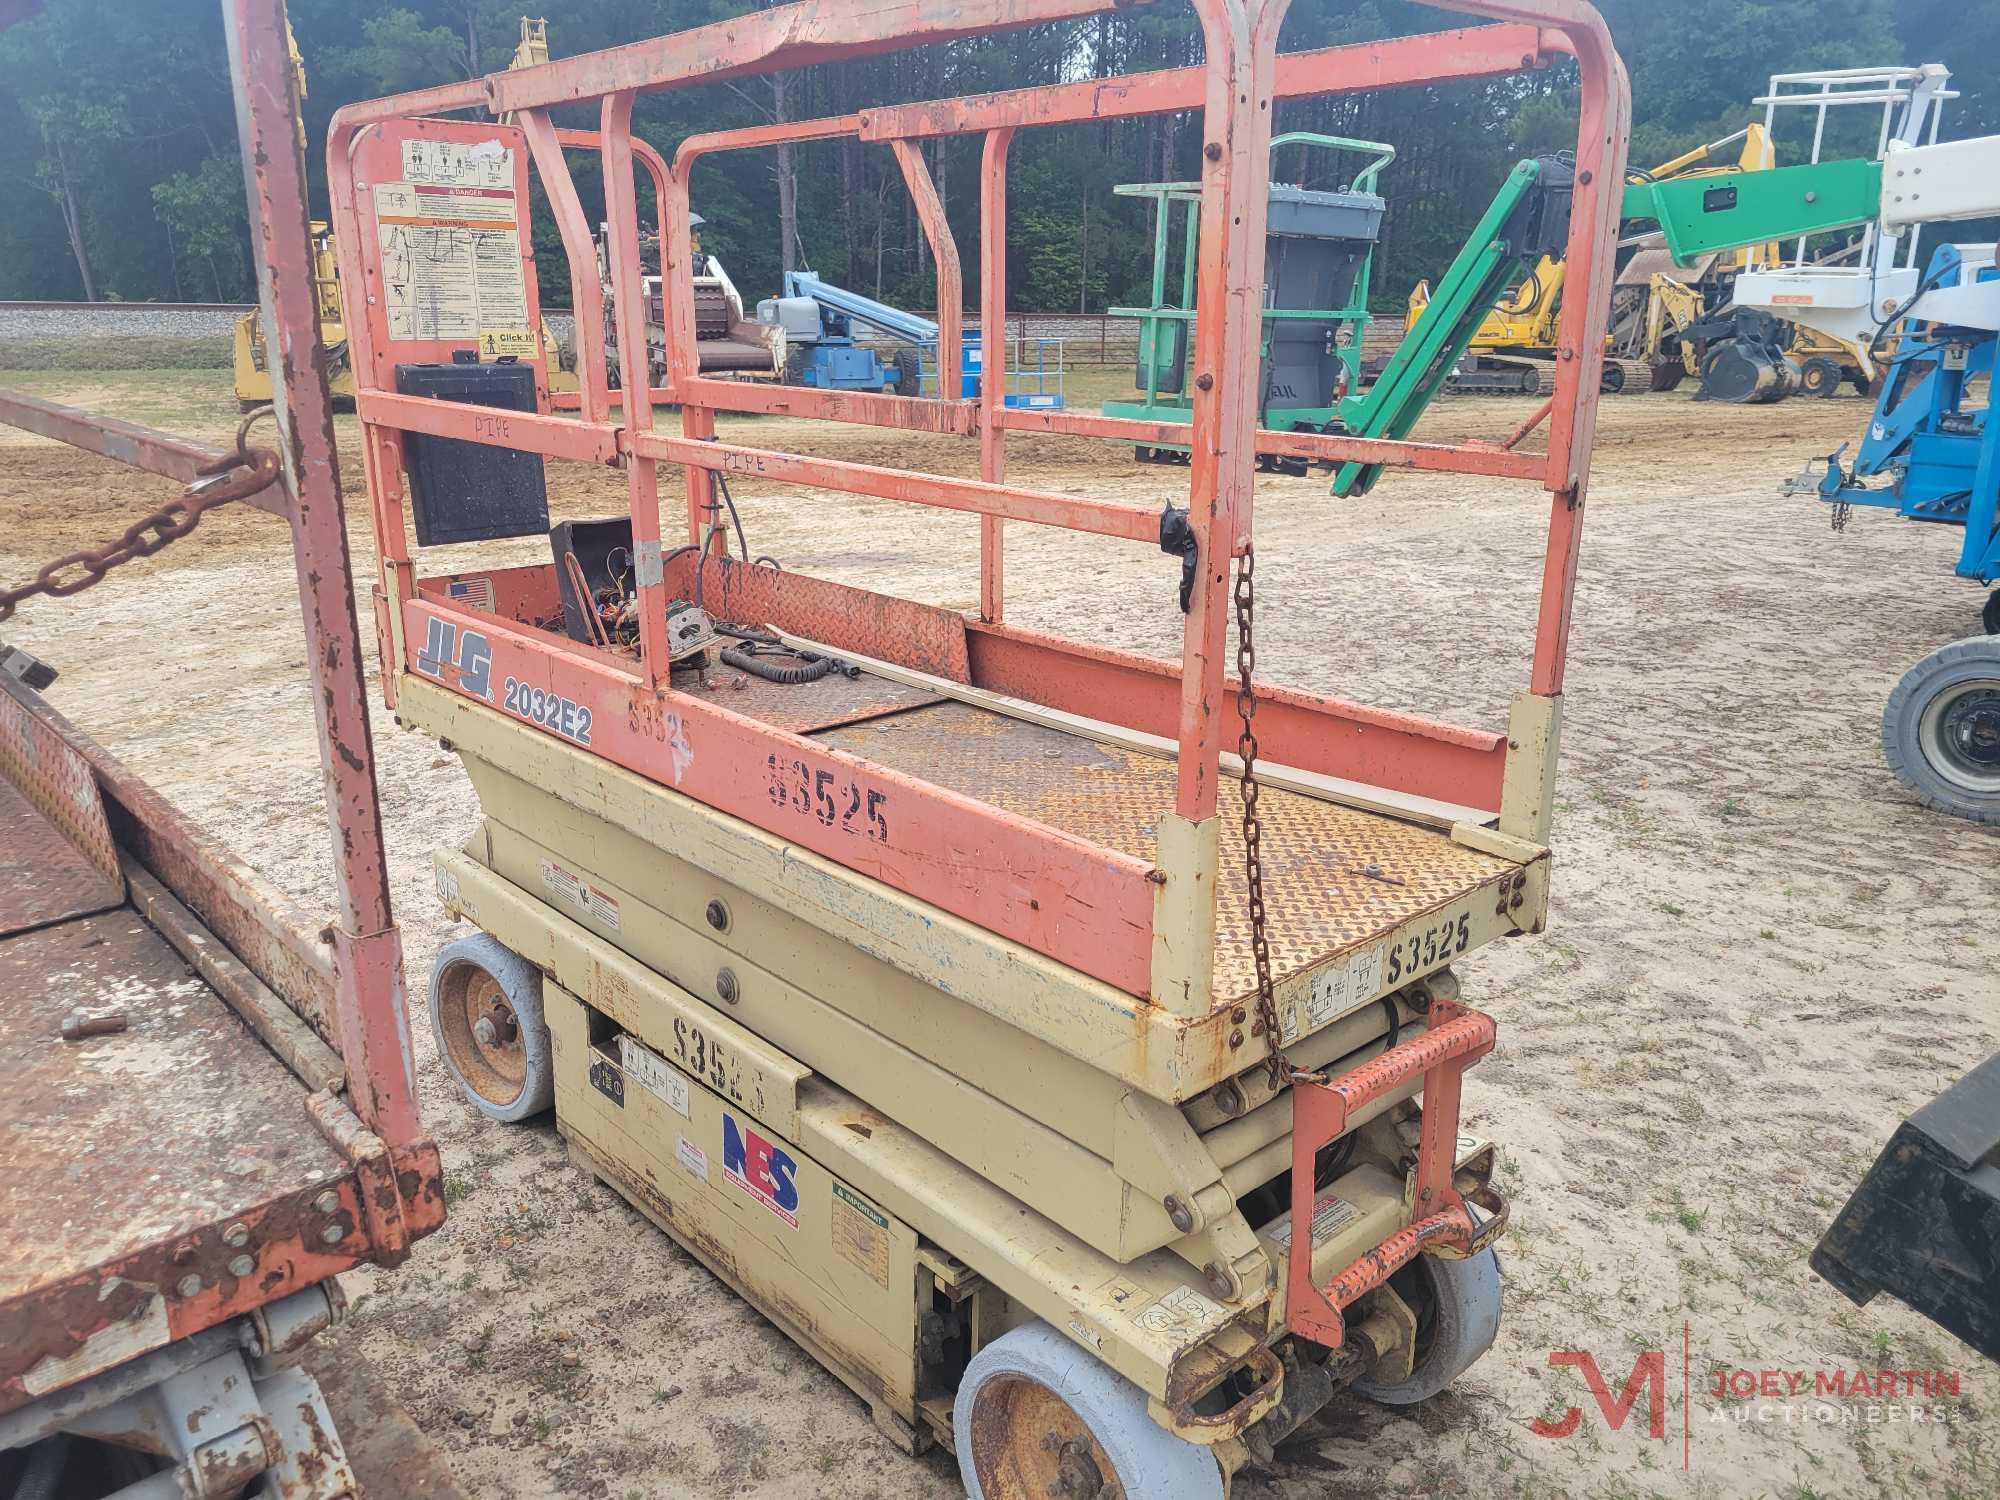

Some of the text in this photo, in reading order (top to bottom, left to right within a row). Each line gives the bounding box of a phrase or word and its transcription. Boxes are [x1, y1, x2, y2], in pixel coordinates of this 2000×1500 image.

[455, 189, 483, 197] DANGER
[499, 333, 522, 342] Click
[723, 450, 765, 471] PIPE
[416, 615, 494, 700] JLG
[503, 676, 593, 749] 2032E2
[1387, 911, 1470, 984] S3525
[722, 1111, 800, 1214] NES
[844, 1193, 882, 1226] IMPORTANT
